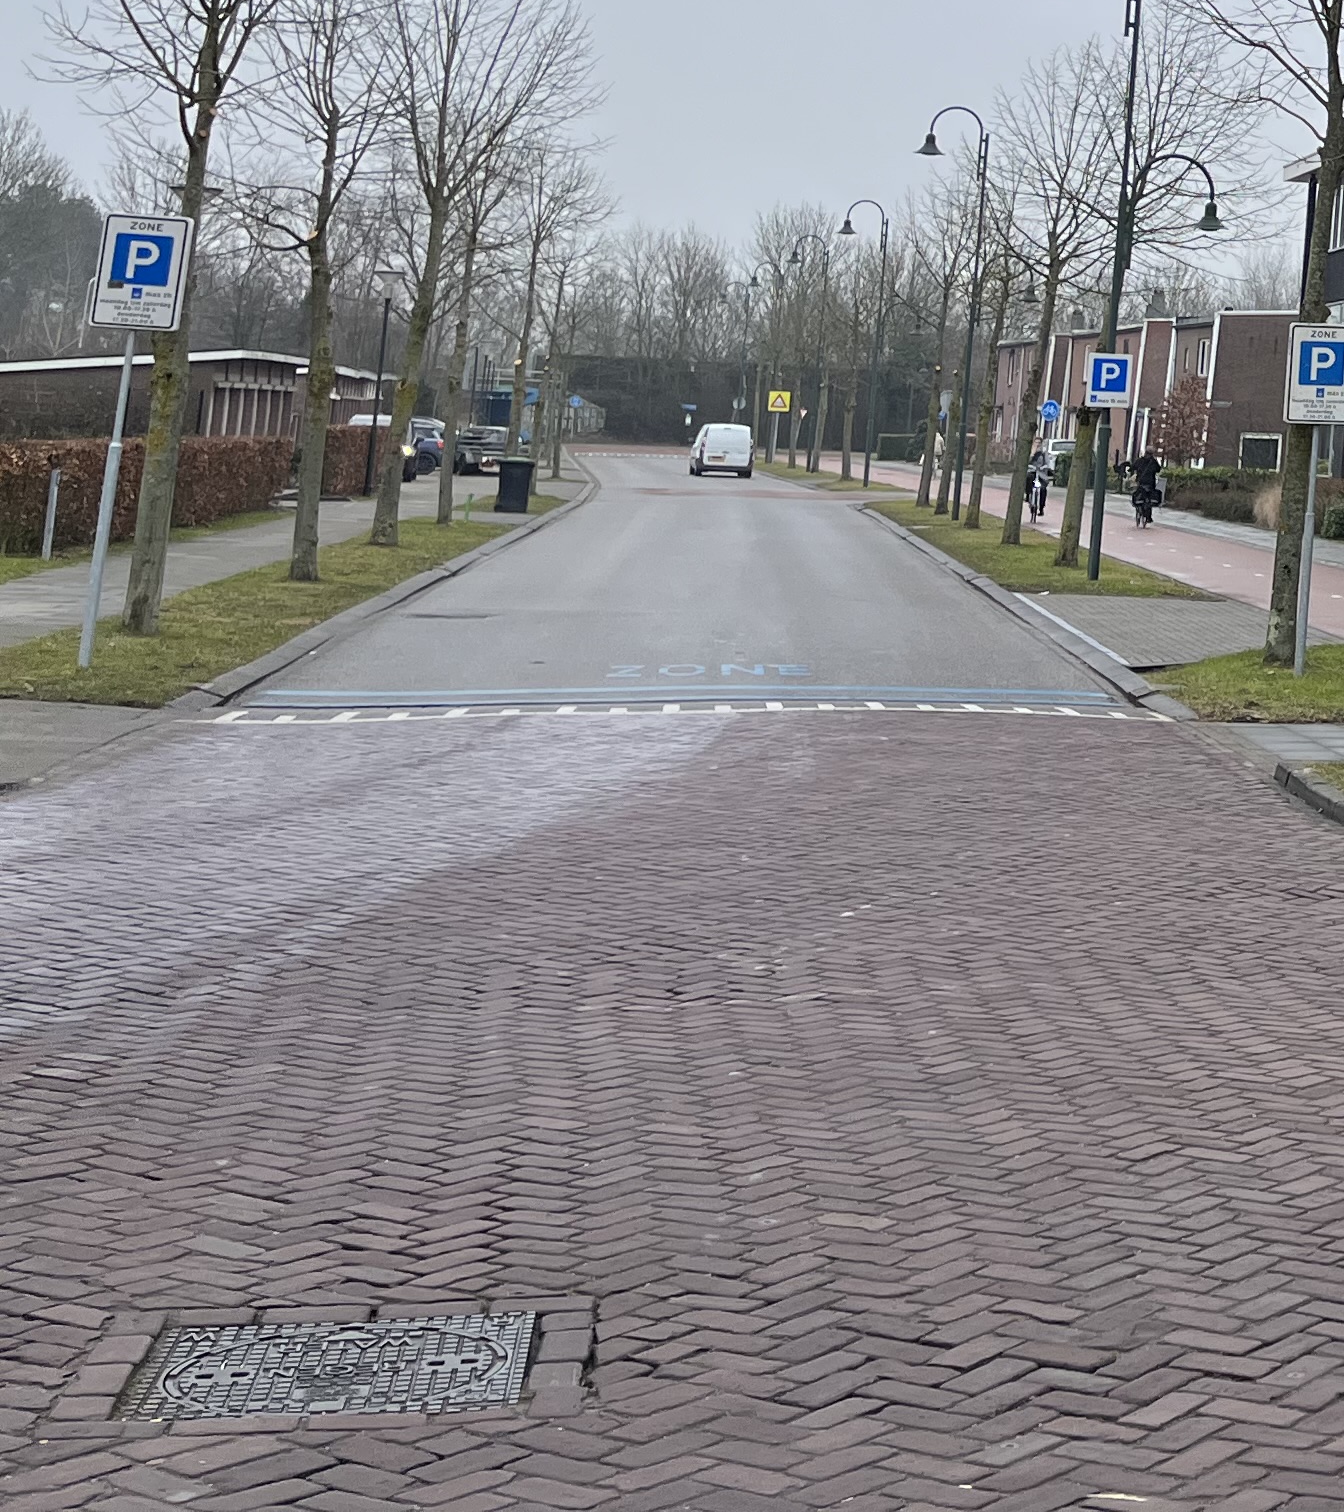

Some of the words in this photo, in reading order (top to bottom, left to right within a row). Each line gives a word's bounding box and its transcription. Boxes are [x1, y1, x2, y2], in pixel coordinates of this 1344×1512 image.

[129, 221, 165, 232] ZONE
[125, 239, 161, 279] P
[1310, 331, 1338, 339] ZONE
[1309, 346, 1337, 381] P
[1099, 362, 1121, 389] P
[605, 663, 813, 678] ZONE
[276, 1336, 413, 1354] WATER
[265, 1362, 407, 1379] REGEN
